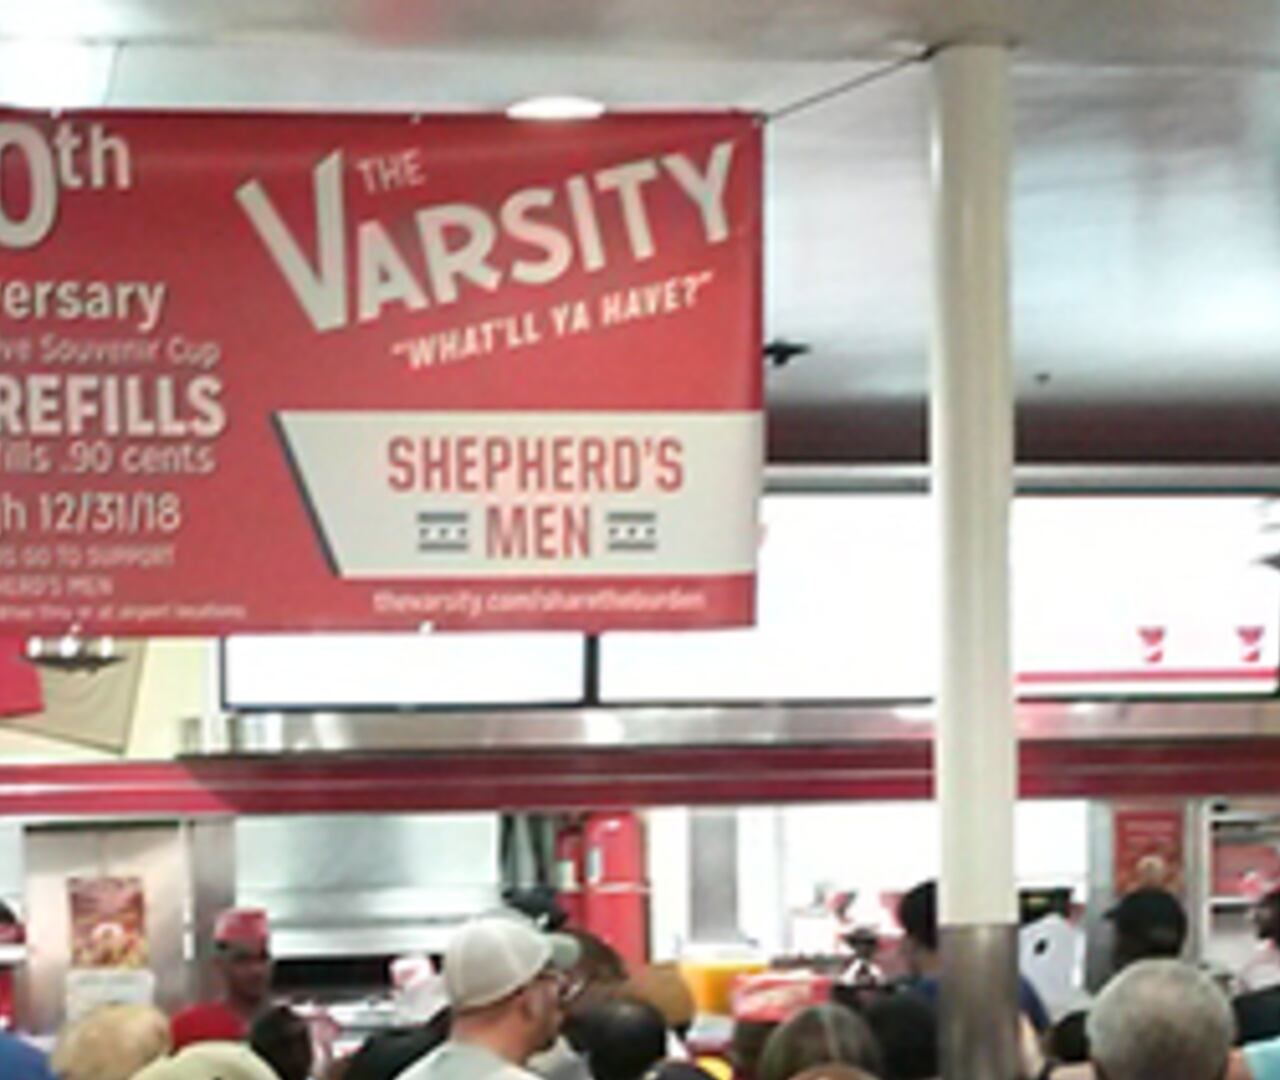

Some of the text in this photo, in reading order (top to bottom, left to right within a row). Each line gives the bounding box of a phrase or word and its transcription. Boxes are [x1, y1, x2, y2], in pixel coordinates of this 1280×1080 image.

[357, 148, 427, 192] THE
[235, 141, 734, 334] VARSITY
[552, 302, 591, 340] YA
[167, 336, 220, 368] Cup
[61, 441, 112, 473] .90
[122, 442, 216, 474] cents
[386, 437, 685, 493] SHEPHERD'S
[39, 492, 183, 537] 12/31/18
[485, 506, 592, 561] MEN
